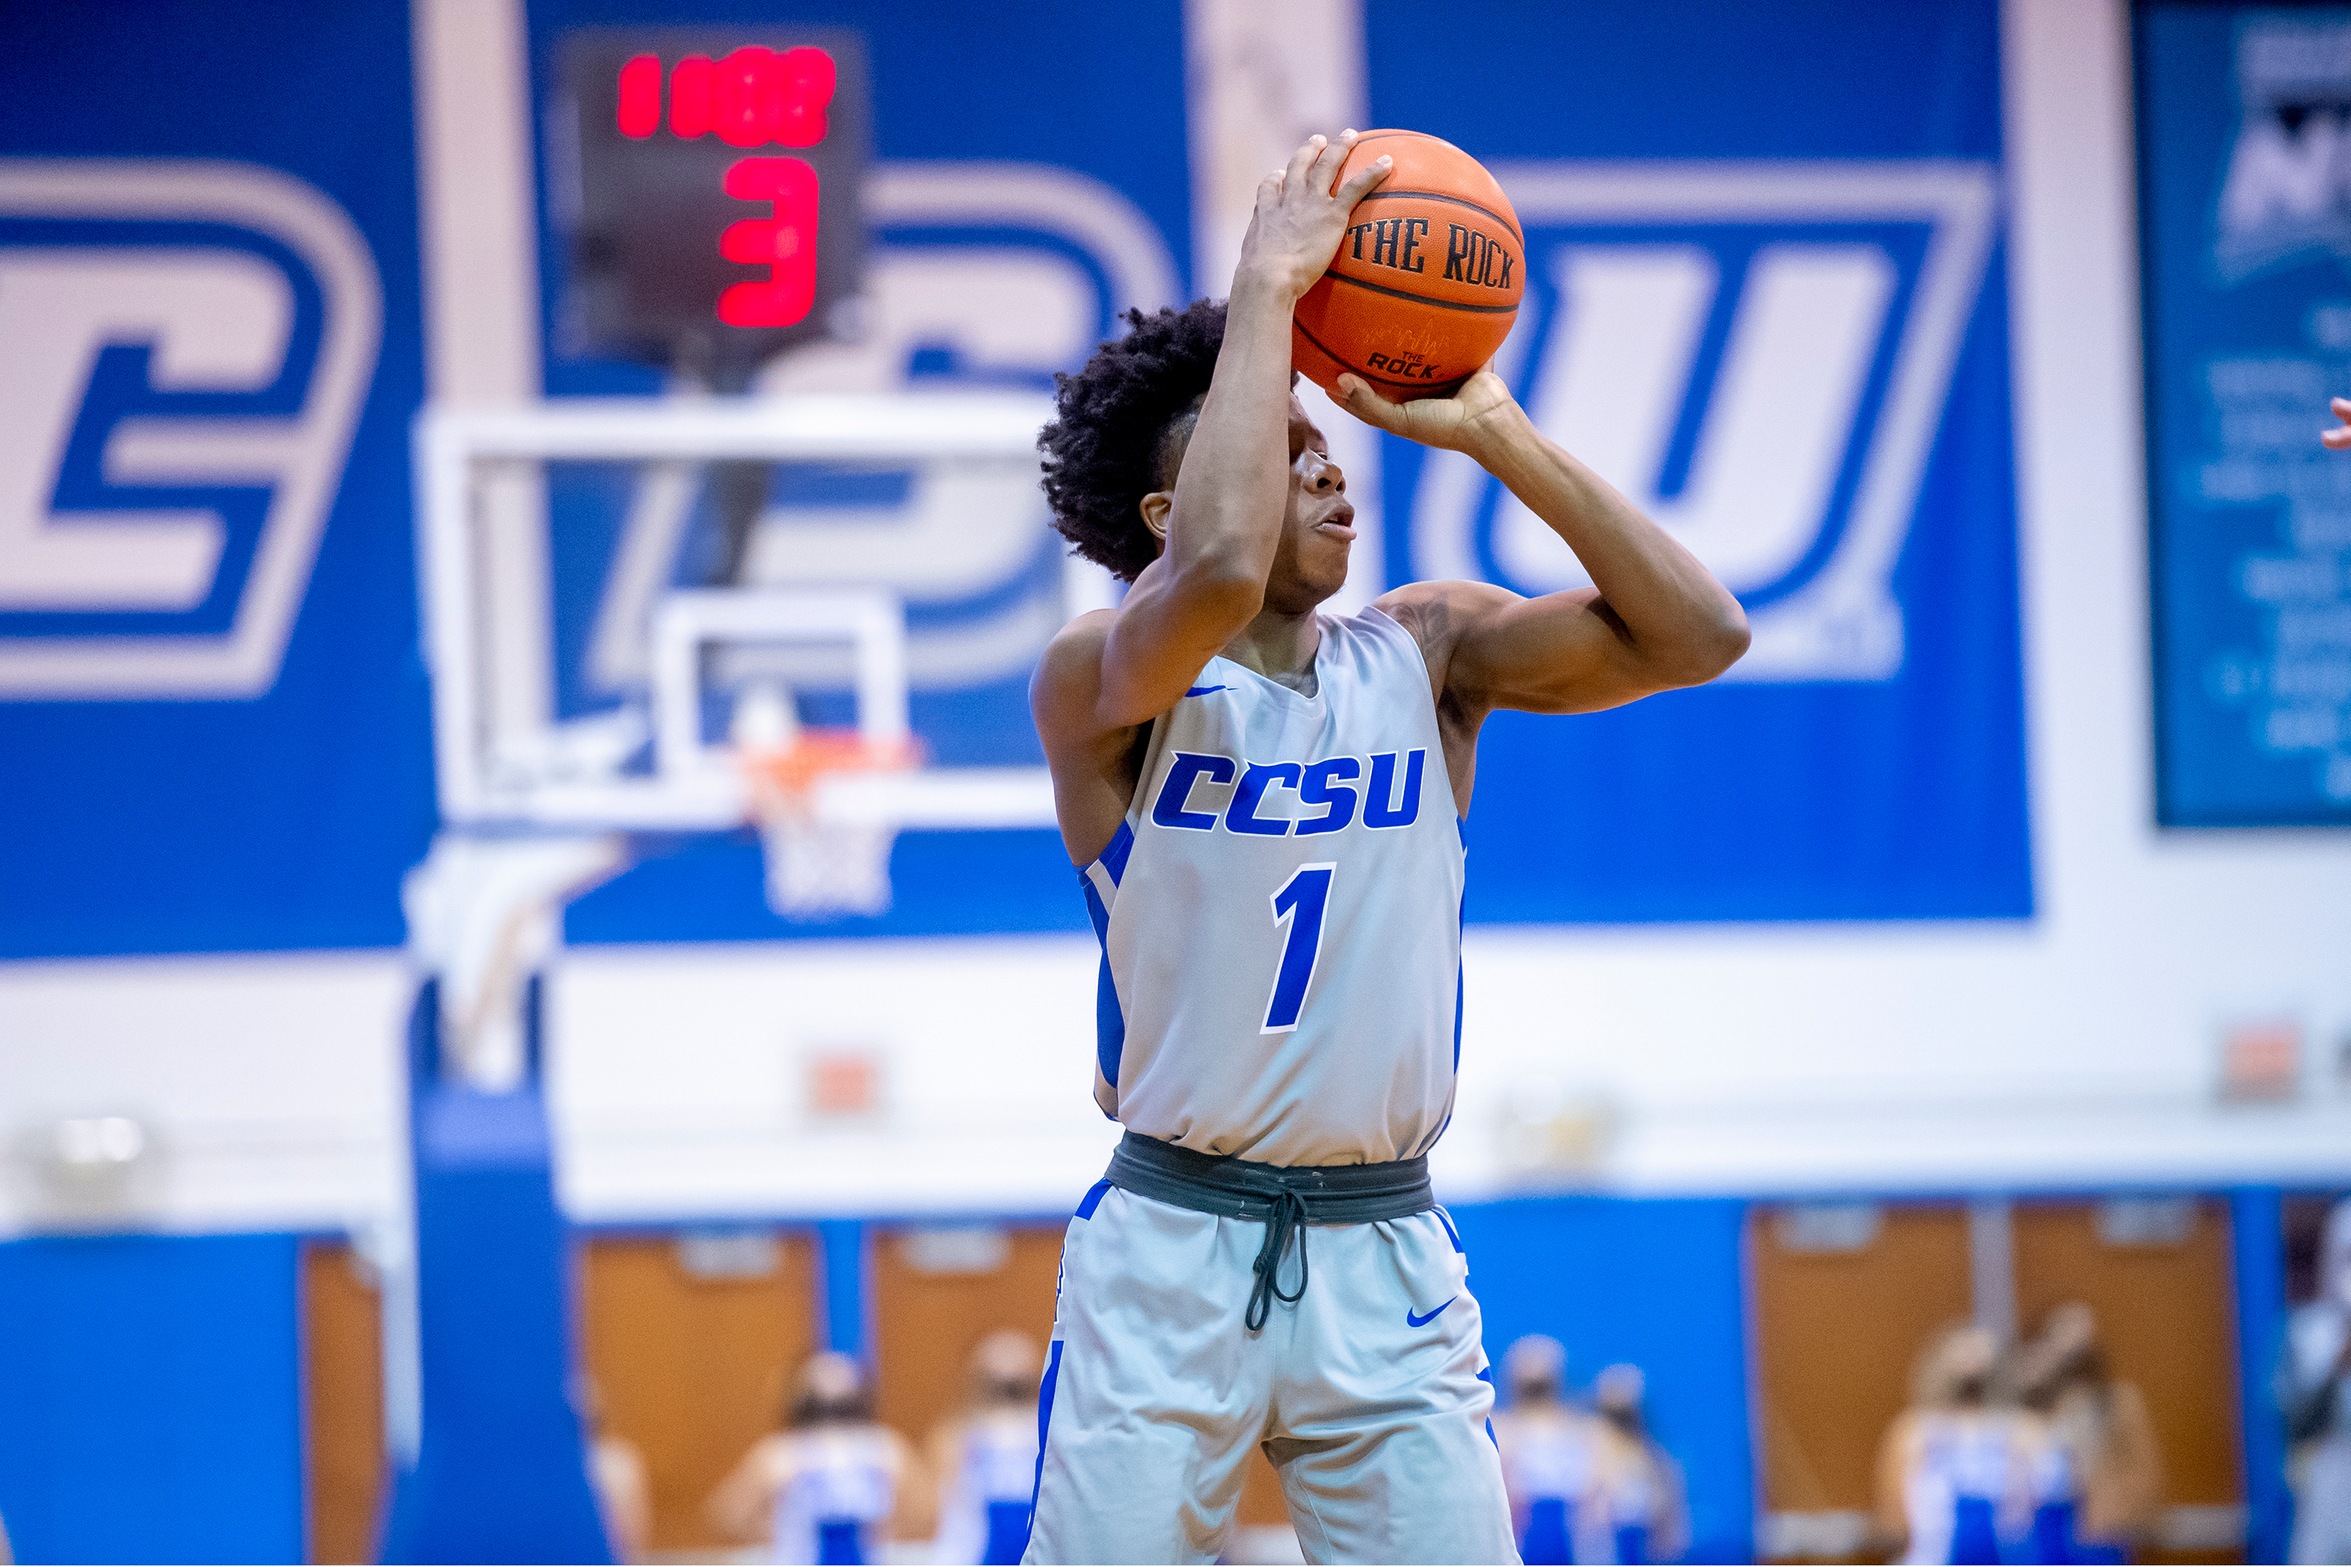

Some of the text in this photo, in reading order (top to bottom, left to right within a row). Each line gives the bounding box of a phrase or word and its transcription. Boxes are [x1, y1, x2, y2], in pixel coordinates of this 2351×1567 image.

[717, 156, 819, 327] 3
[1348, 218, 1514, 290] THE ROCK
[1366, 352, 1440, 378] ROCK
[1402, 351, 1426, 363] THE
[1150, 747, 1428, 838] CCSU
[1259, 861, 1337, 1034] 1
